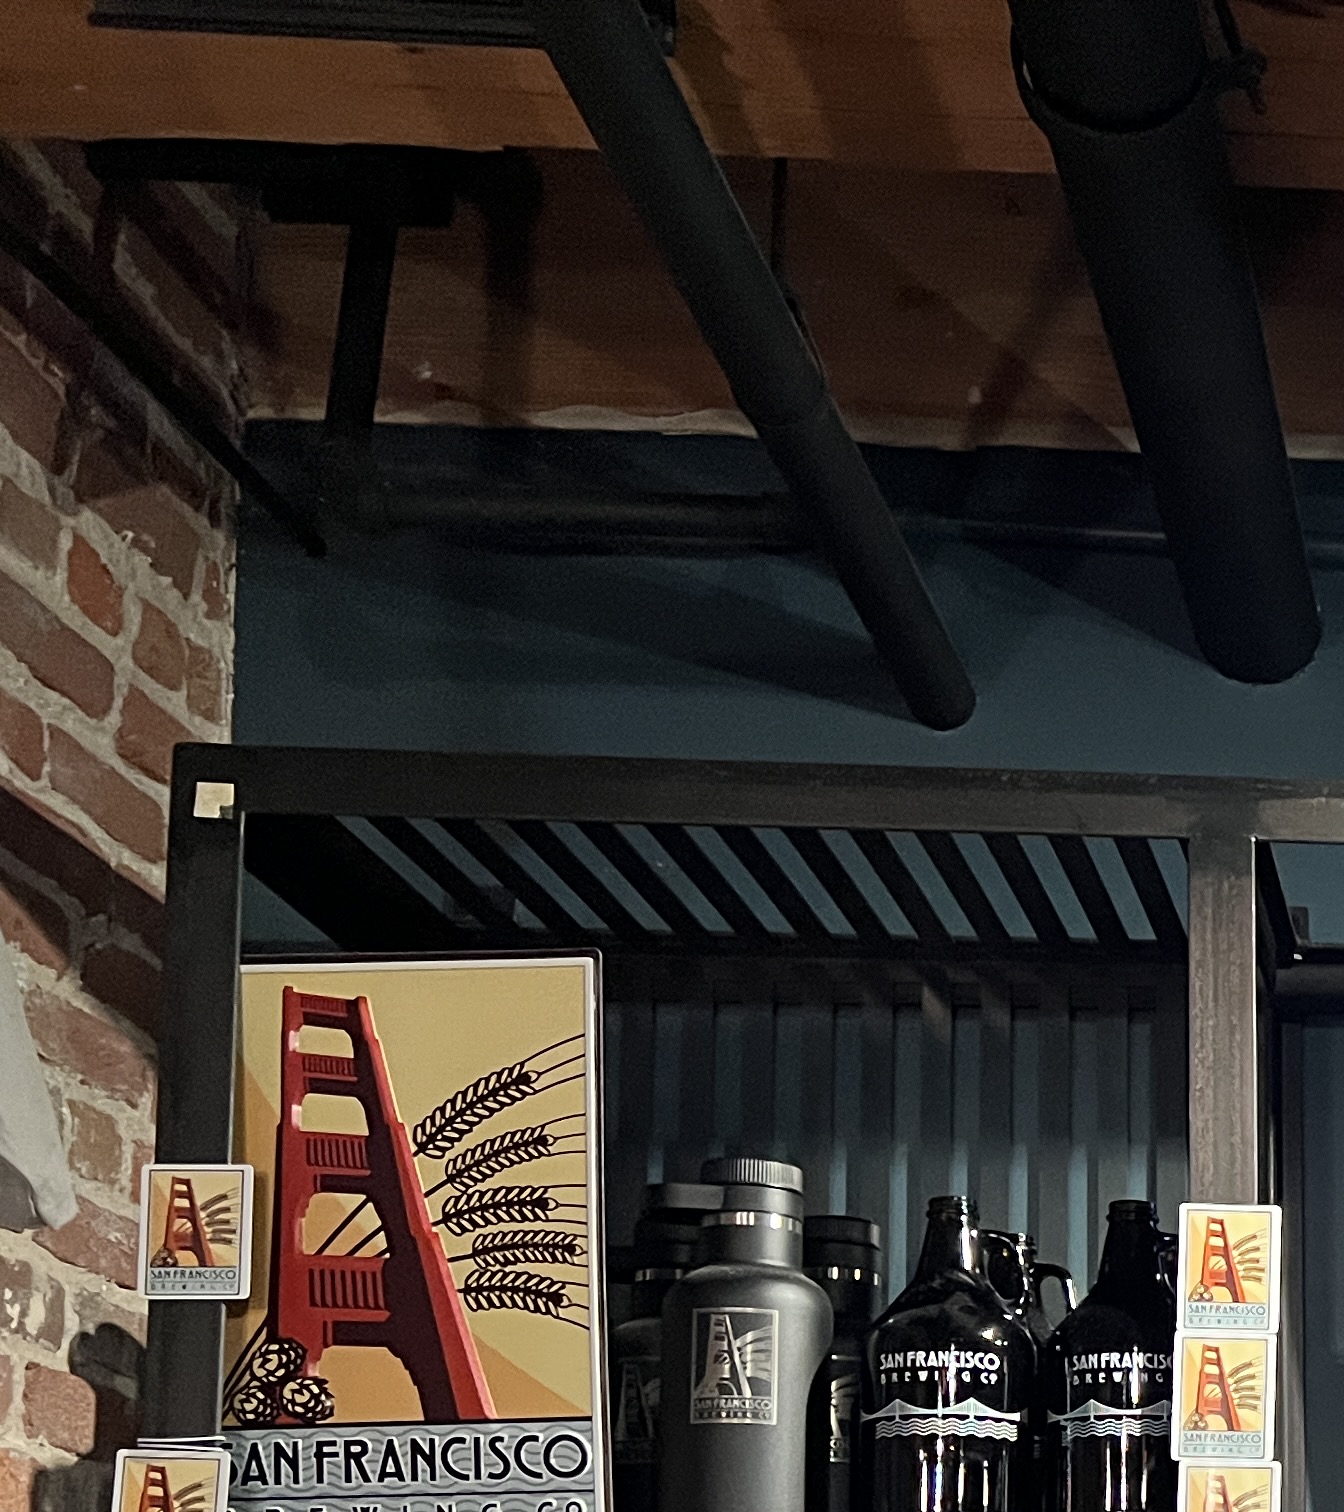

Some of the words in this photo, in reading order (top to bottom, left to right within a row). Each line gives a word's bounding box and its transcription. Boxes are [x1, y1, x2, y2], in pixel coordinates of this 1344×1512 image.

[880, 1354, 903, 1369] SAN
[907, 1352, 1000, 1371] FRANCISCO
[314, 1434, 590, 1484] FRANCISCO
